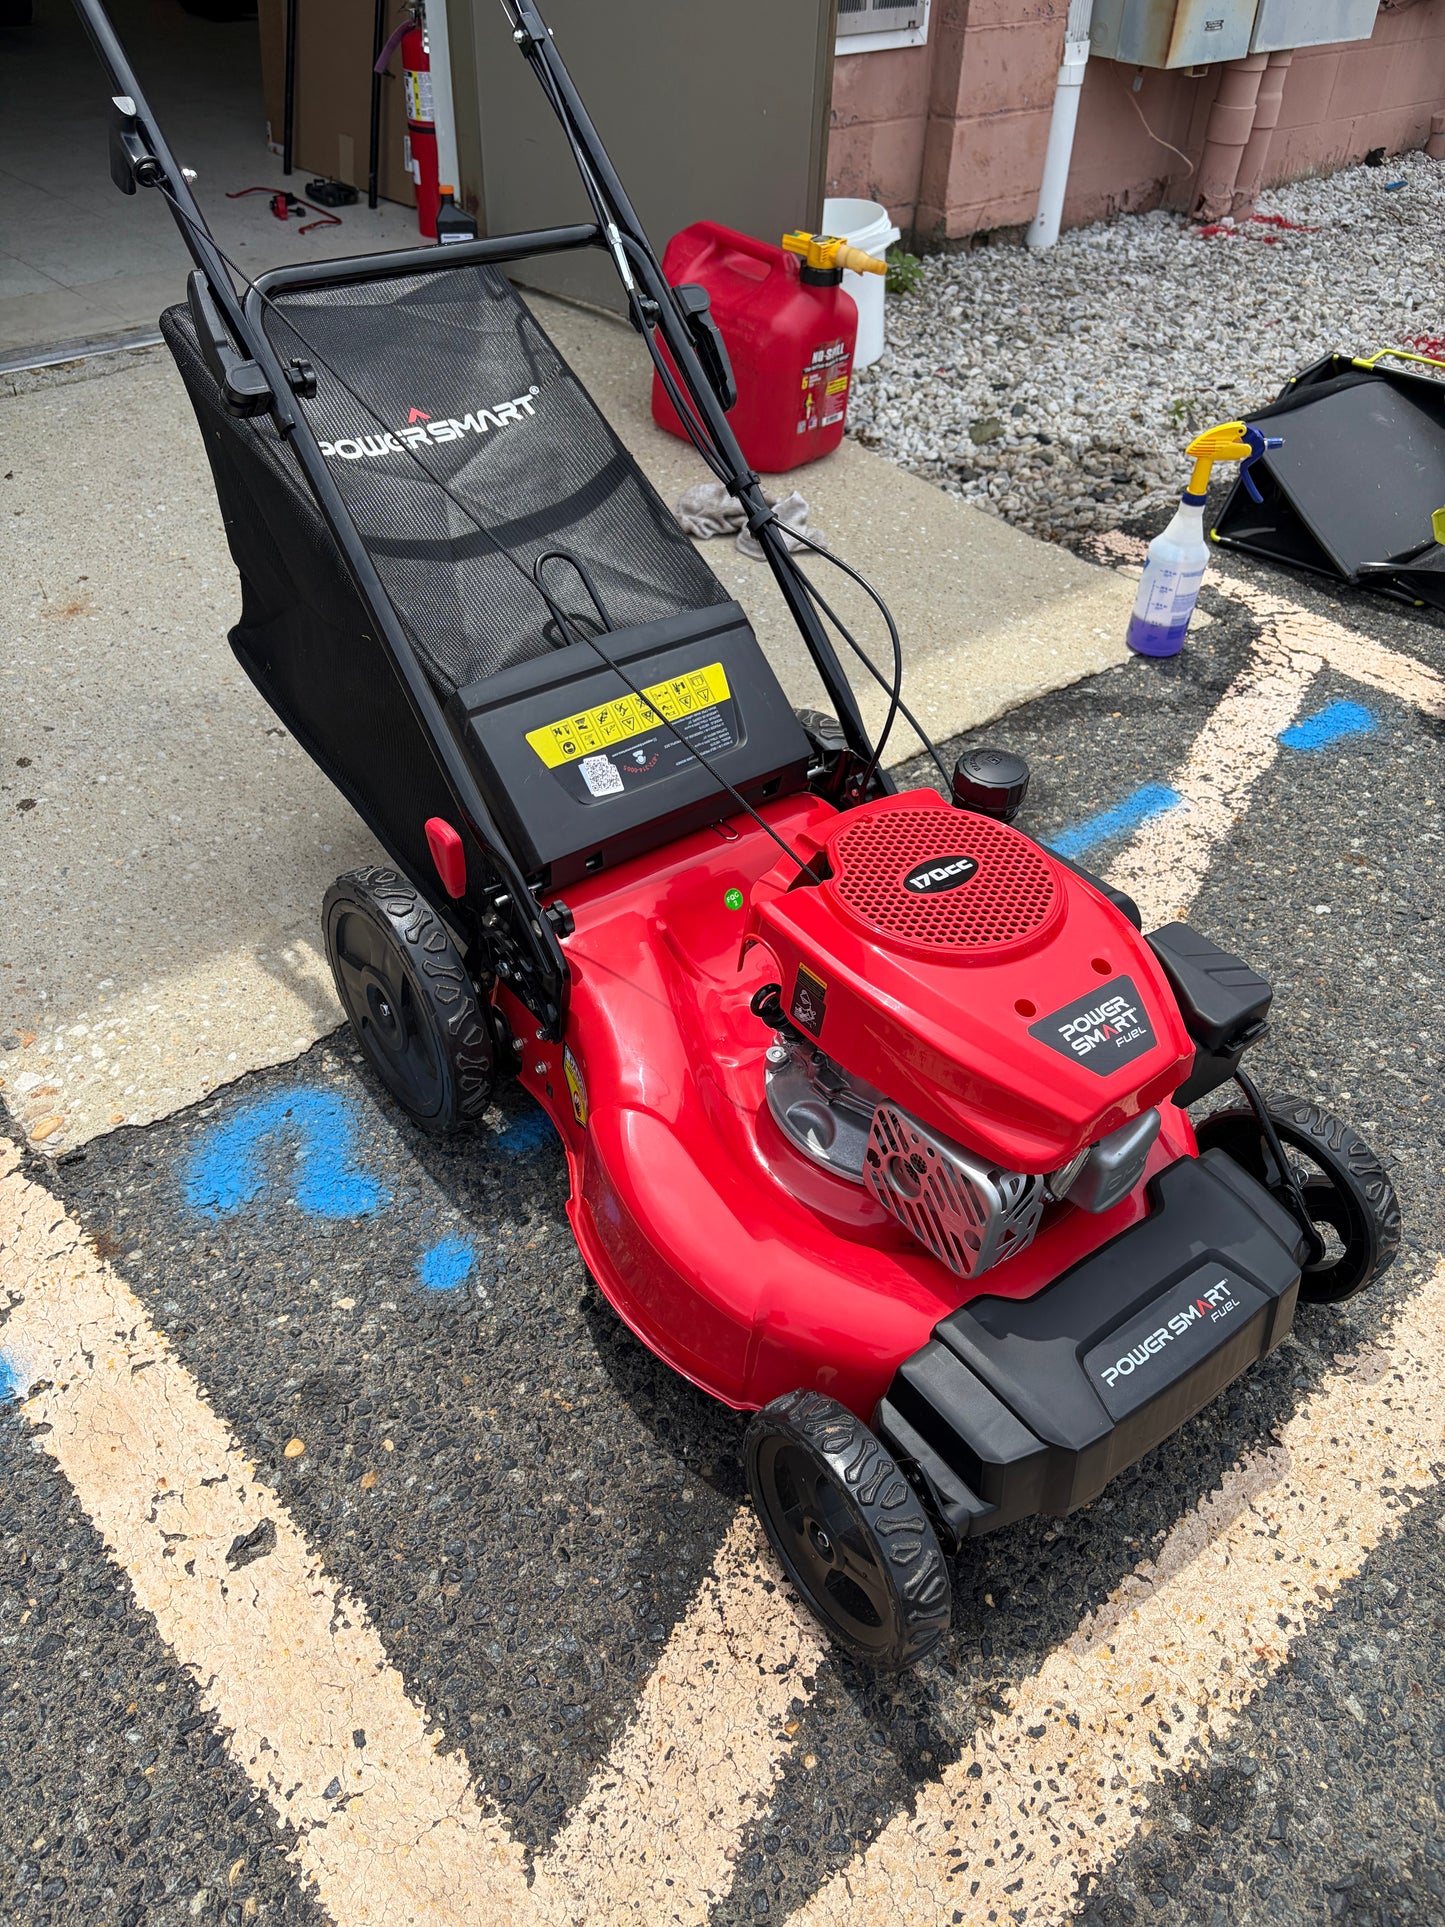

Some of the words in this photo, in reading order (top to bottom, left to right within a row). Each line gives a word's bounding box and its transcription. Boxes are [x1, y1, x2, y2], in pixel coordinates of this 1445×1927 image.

[1058, 996, 1130, 1041] POWER
[1071, 1008, 1138, 1056] SMART
[1115, 1027, 1147, 1047] FUEL
[1210, 1299, 1240, 1323] FUEL
